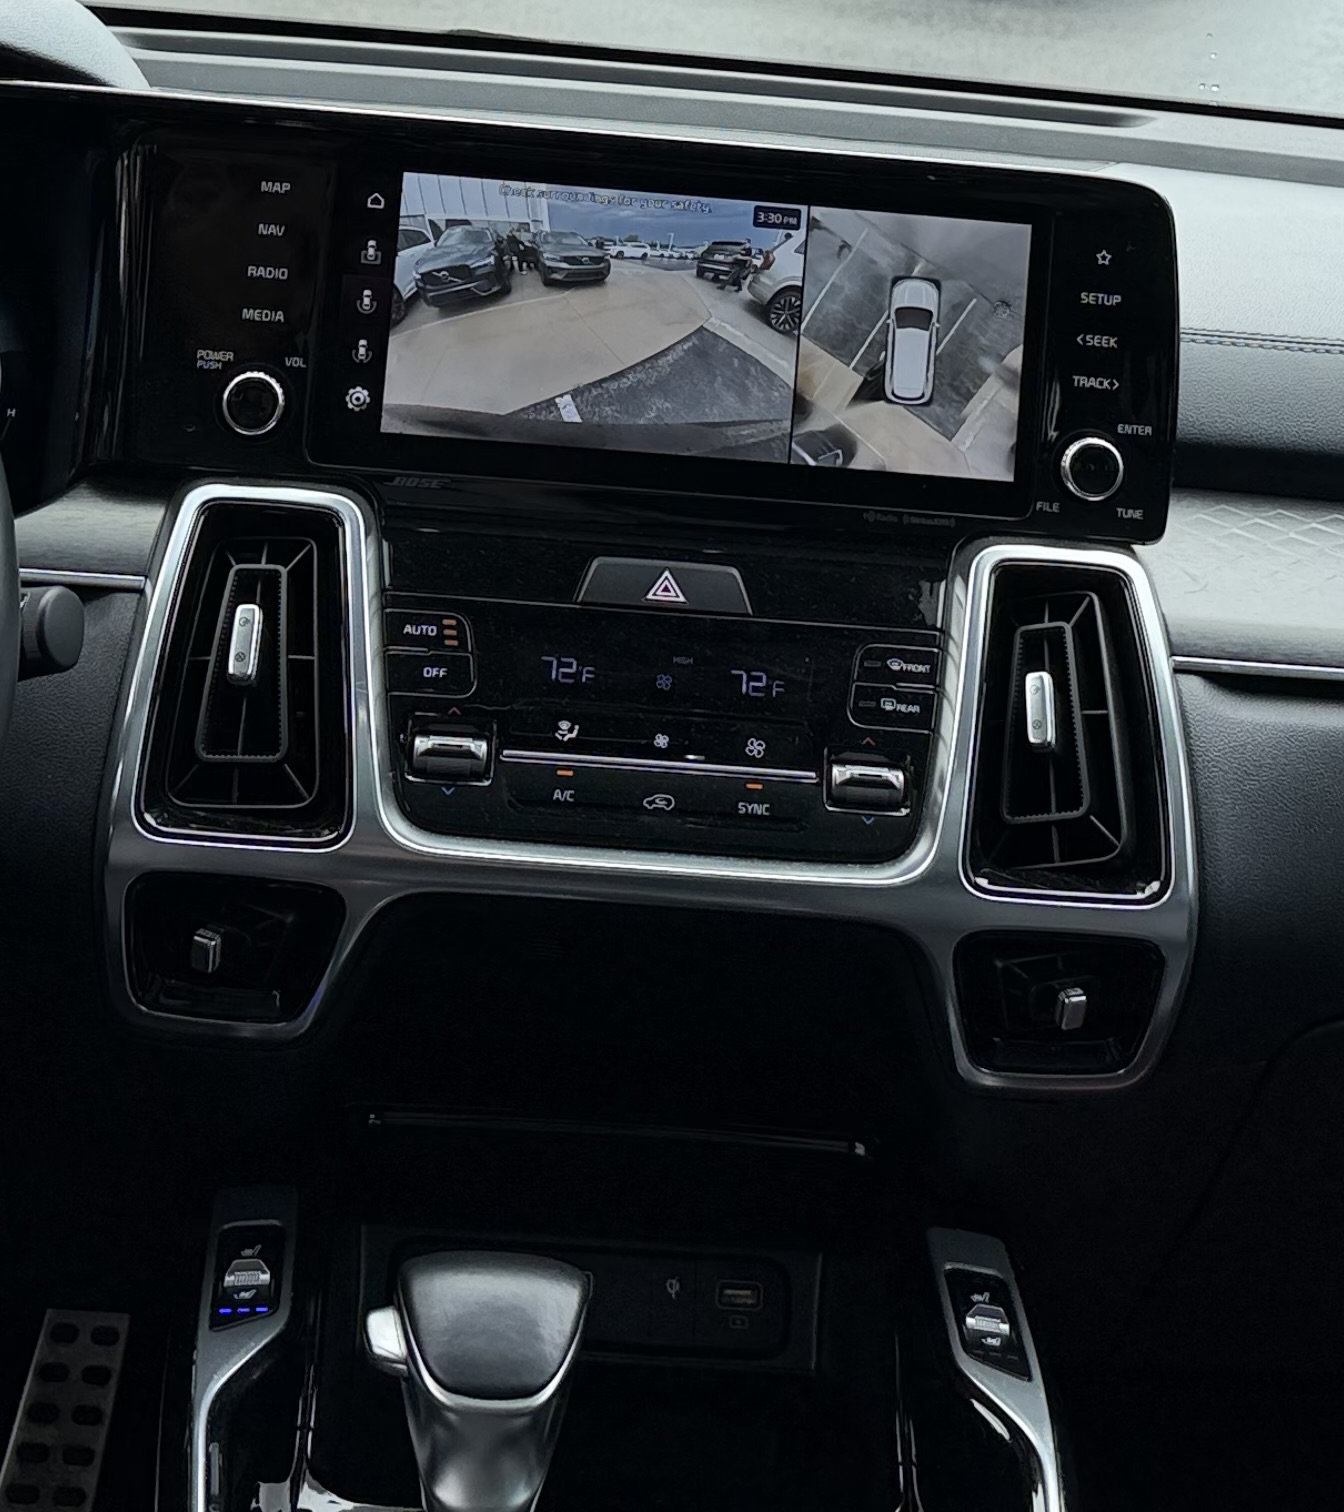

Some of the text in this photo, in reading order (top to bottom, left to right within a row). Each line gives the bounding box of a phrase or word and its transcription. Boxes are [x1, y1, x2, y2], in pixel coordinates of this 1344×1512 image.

[260, 181, 291, 195] MAP
[757, 211, 782, 225] 3:30
[257, 223, 285, 237] NAV
[247, 265, 288, 280] RADIO
[1080, 292, 1121, 306] SETUP
[241, 308, 285, 323] MEDIA
[196, 349, 234, 363] POWER
[284, 357, 307, 368] VOL
[196, 360, 222, 370] PUSH
[7, 408, 16, 418] H
[1117, 424, 1152, 437] ENTER
[392, 476, 451, 489] BOSE
[1036, 501, 1060, 513] FILE
[1116, 508, 1144, 520] TUNE
[402, 624, 437, 637] AUTO
[422, 666, 448, 679] OFF
[902, 662, 931, 675] FRONT
[896, 702, 921, 714] REAR
[552, 789, 575, 803] A/C
[737, 802, 771, 816] SYNC
